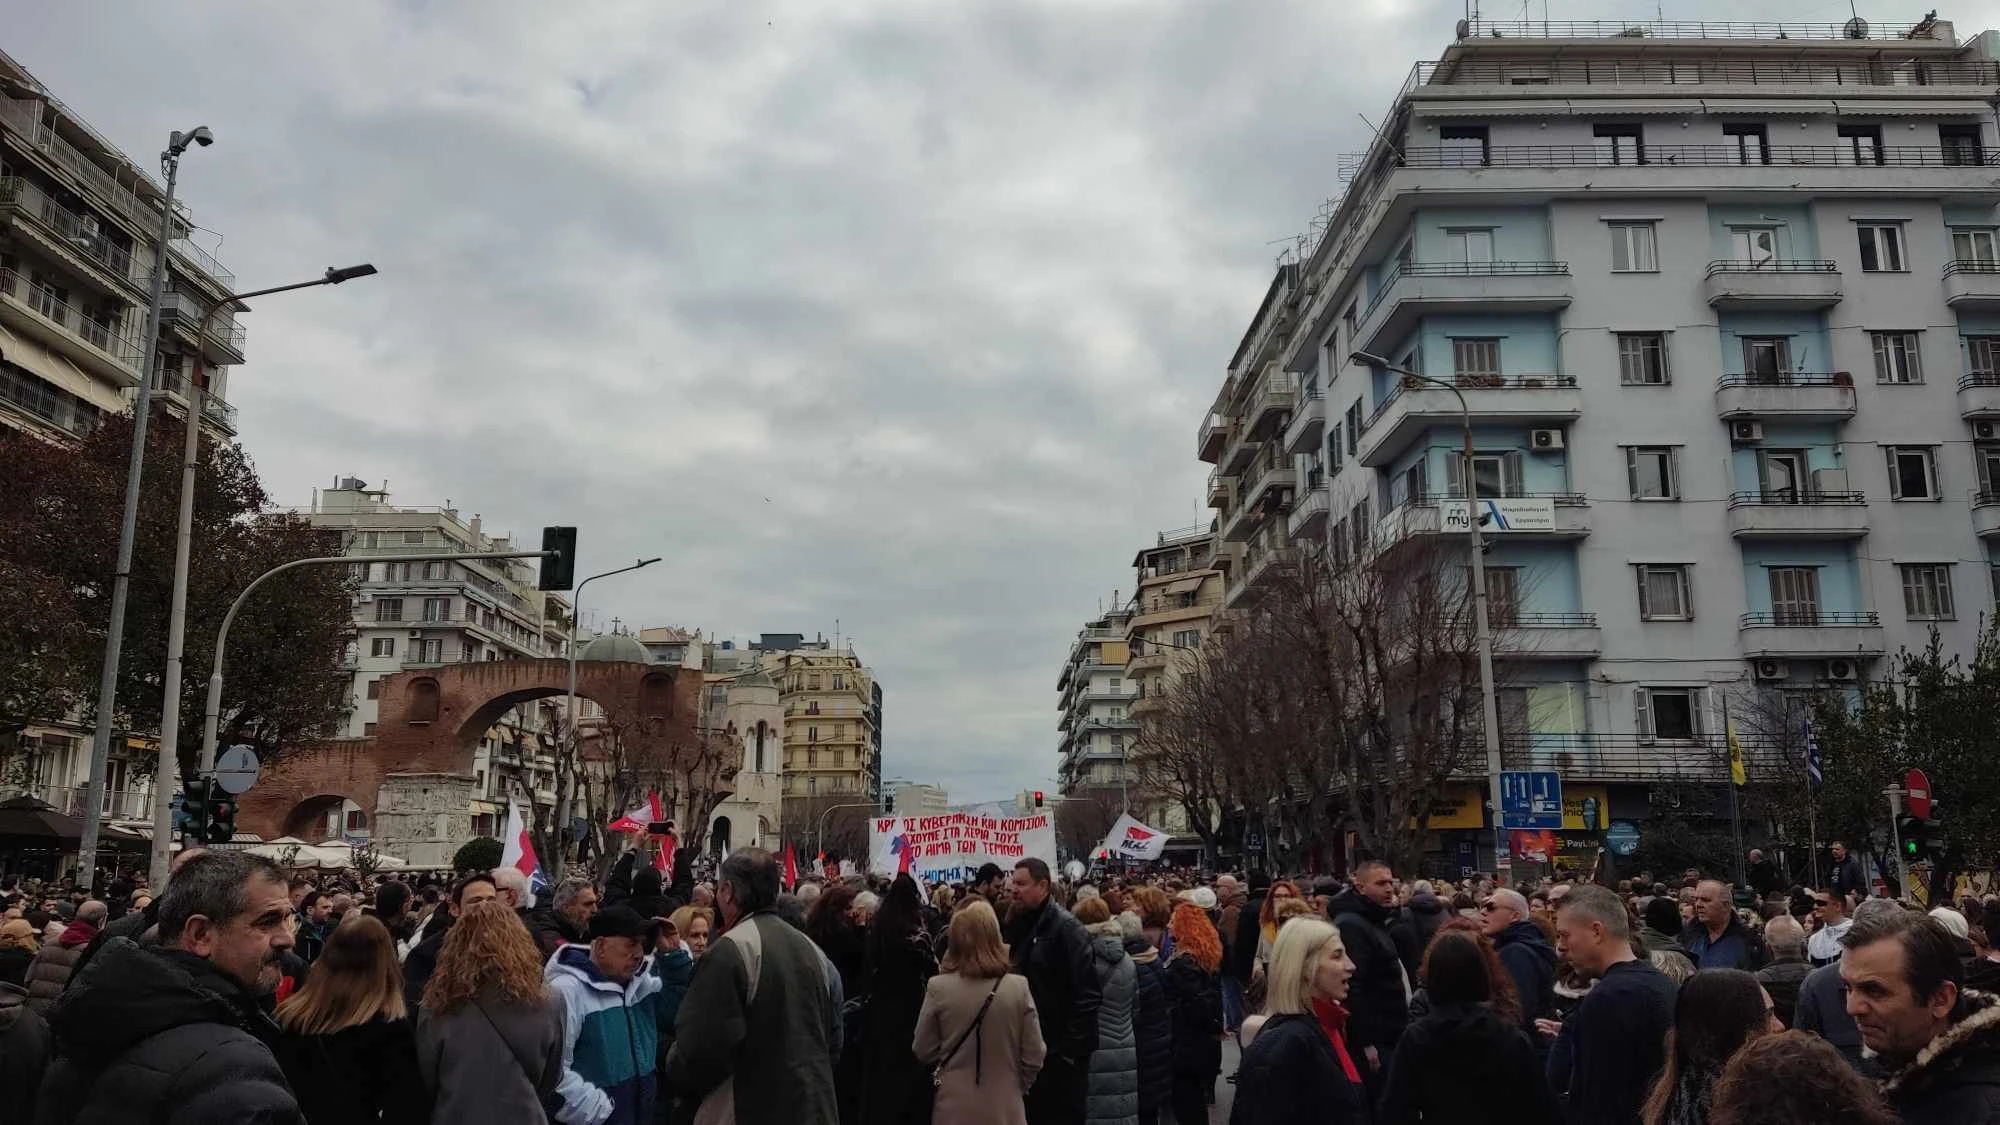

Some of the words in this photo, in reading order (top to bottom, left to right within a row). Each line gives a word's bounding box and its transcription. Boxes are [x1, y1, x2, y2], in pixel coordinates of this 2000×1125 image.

[981, 817, 997, 830] ΚΑΙ
[907, 830, 940, 845] ΧΟΥΝΕ
[964, 827, 989, 840] ΧΕΡΙΑ
[994, 832, 1020, 844] ΤΟΥΣ
[926, 841, 951, 857] ΑΙΜΑ
[957, 840, 976, 854] ΤΩΝ
